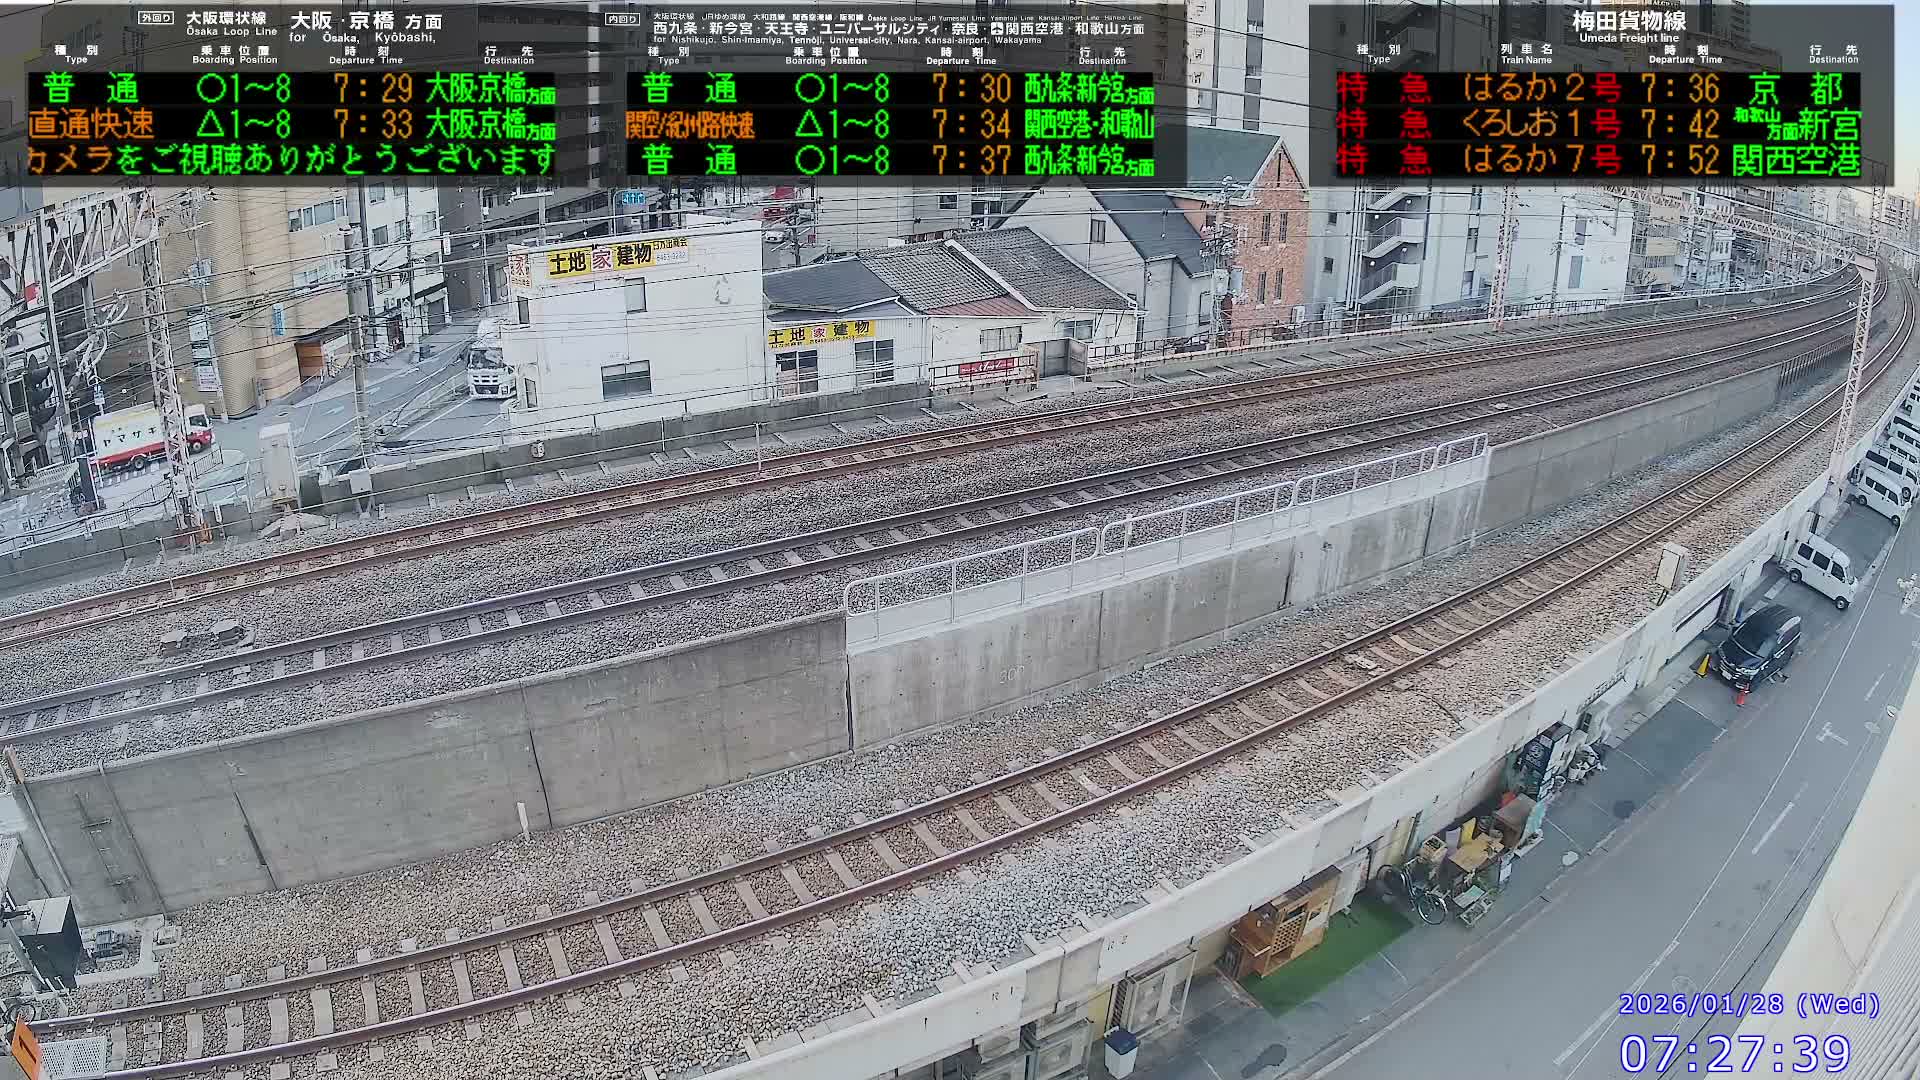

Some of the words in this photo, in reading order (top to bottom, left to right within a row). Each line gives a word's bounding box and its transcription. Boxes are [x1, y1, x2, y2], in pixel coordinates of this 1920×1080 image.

[550, 243, 652, 275] 土地家建物
[768, 321, 867, 345] 土地家建物
